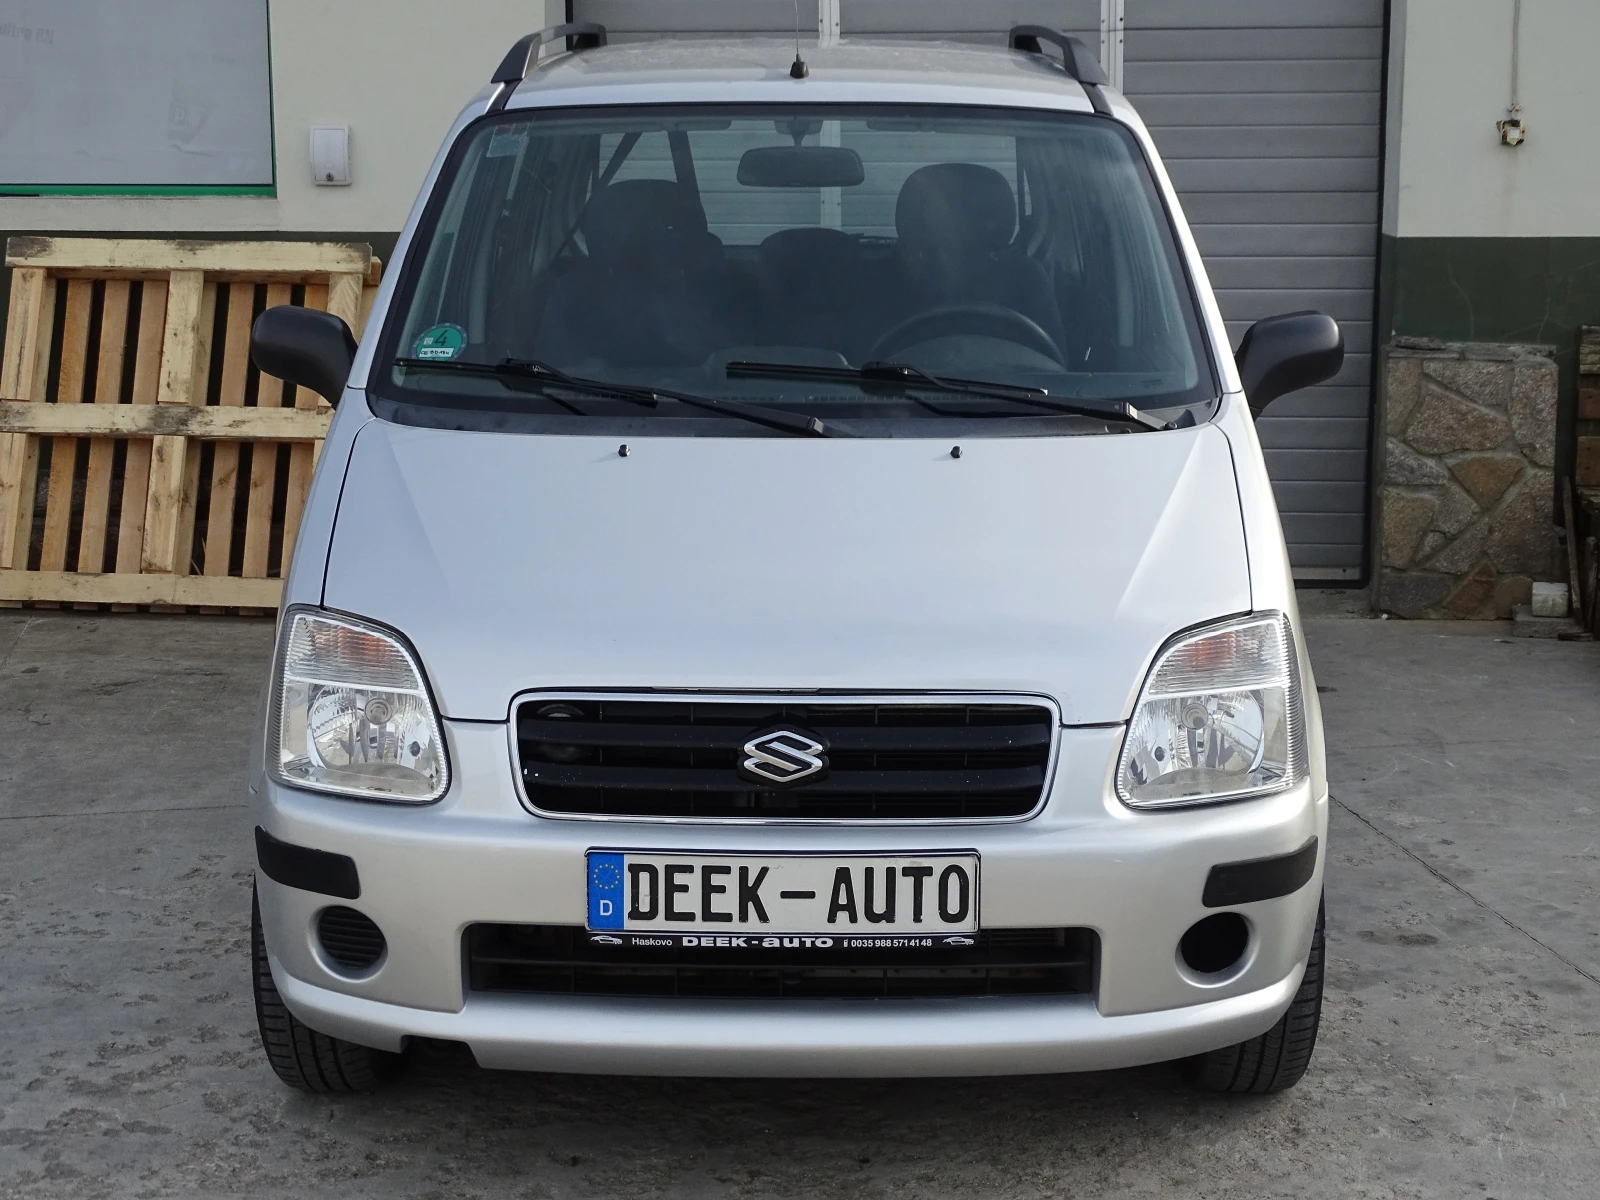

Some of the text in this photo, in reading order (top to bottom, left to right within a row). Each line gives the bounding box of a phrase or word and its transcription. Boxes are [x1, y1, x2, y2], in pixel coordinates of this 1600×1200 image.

[600, 900, 613, 916] D
[632, 937, 673, 946] Haskovo
[851, 939, 873, 947] 0035
